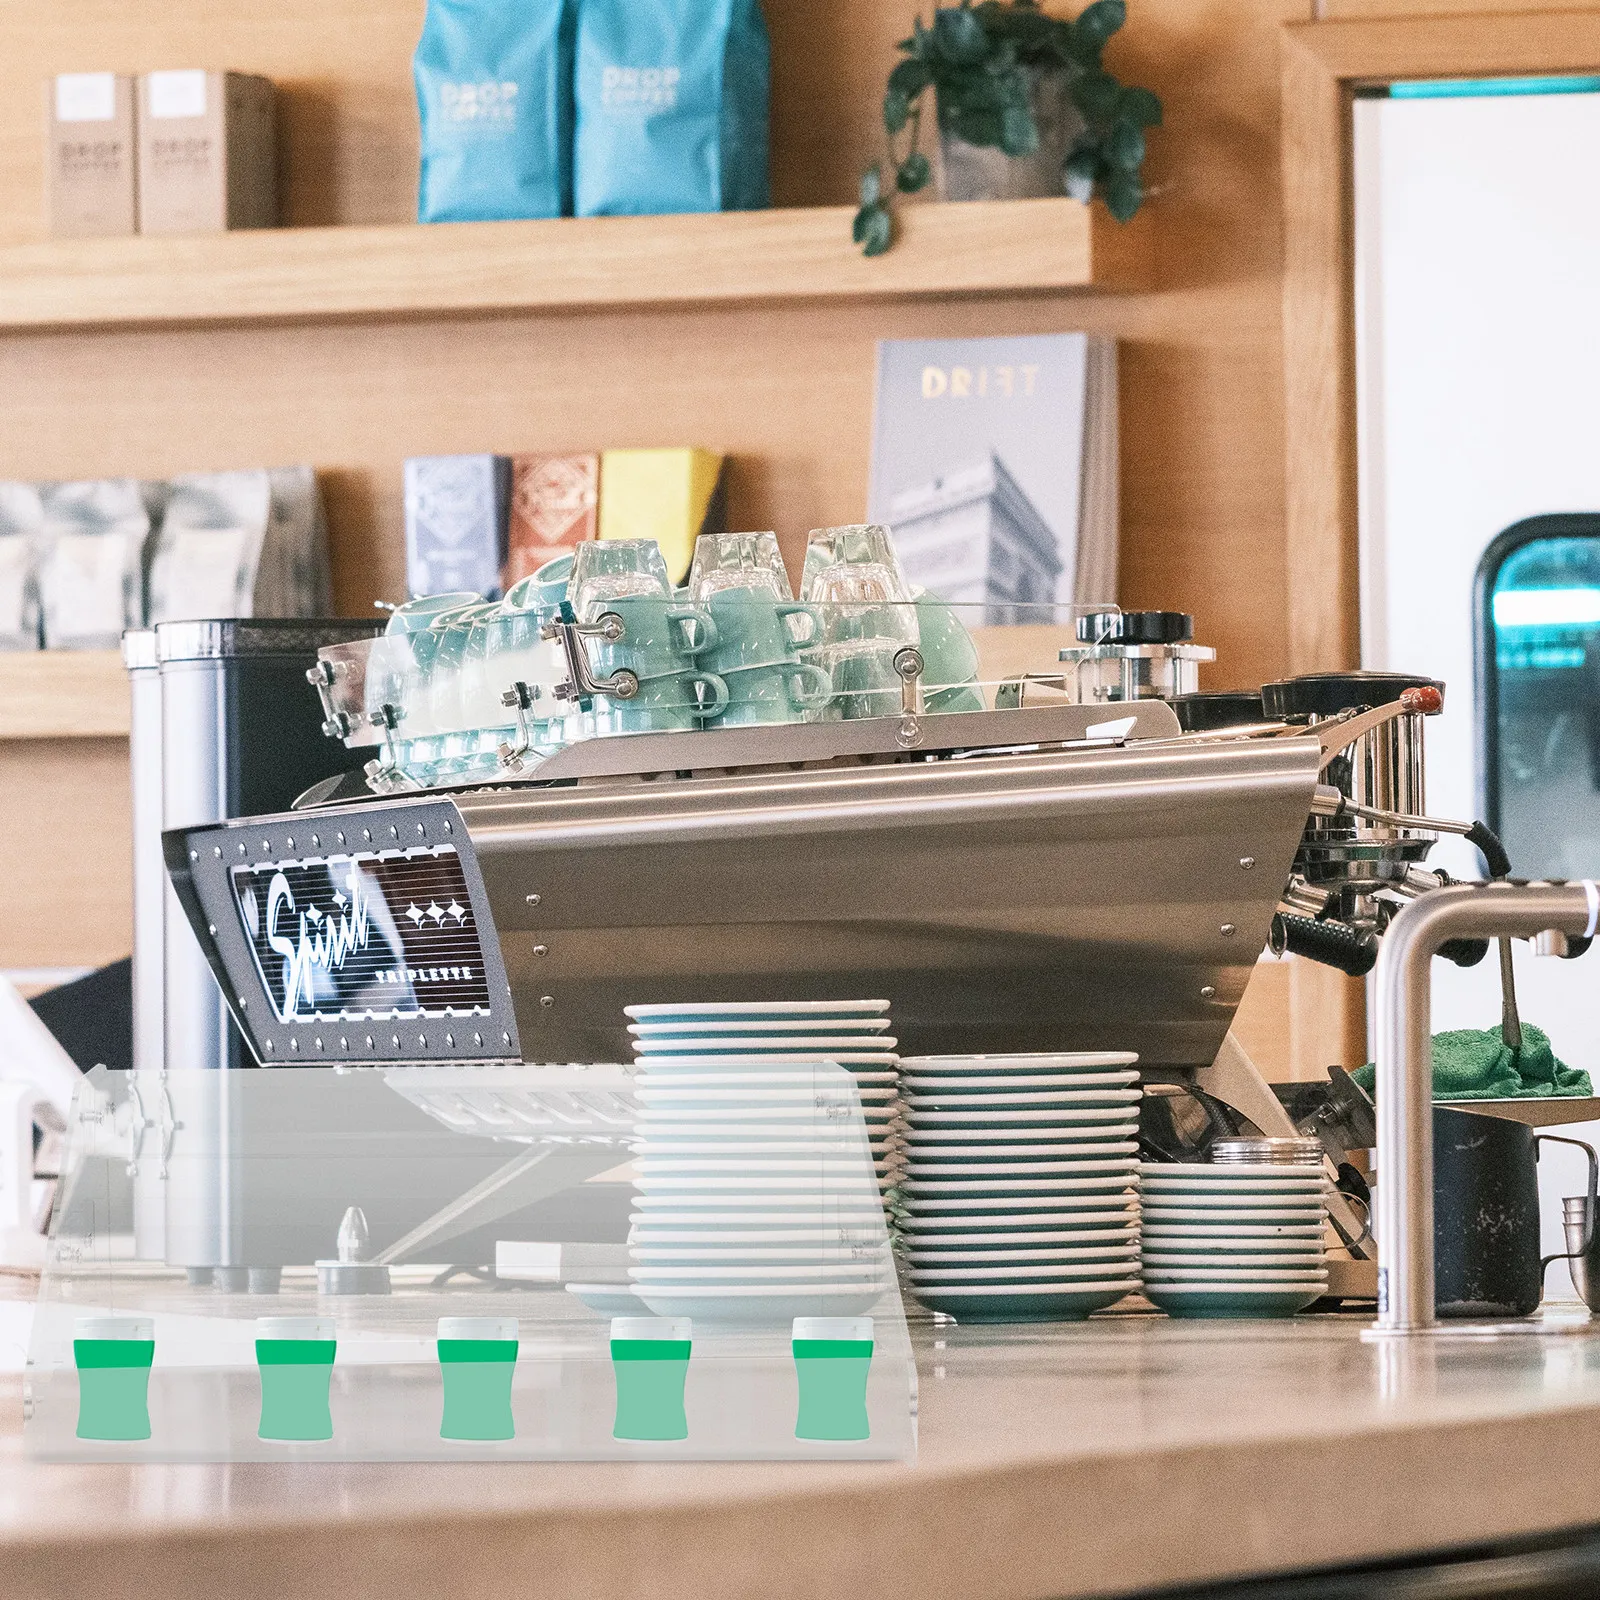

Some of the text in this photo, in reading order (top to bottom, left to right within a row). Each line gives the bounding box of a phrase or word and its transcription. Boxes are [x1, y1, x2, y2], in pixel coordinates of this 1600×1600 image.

[602, 66, 681, 87] DROP
[441, 82, 518, 102] DROP
[60, 141, 122, 159] DROP
[152, 138, 212, 156] DROP
[375, 966, 473, 983] TRIPLETTE
